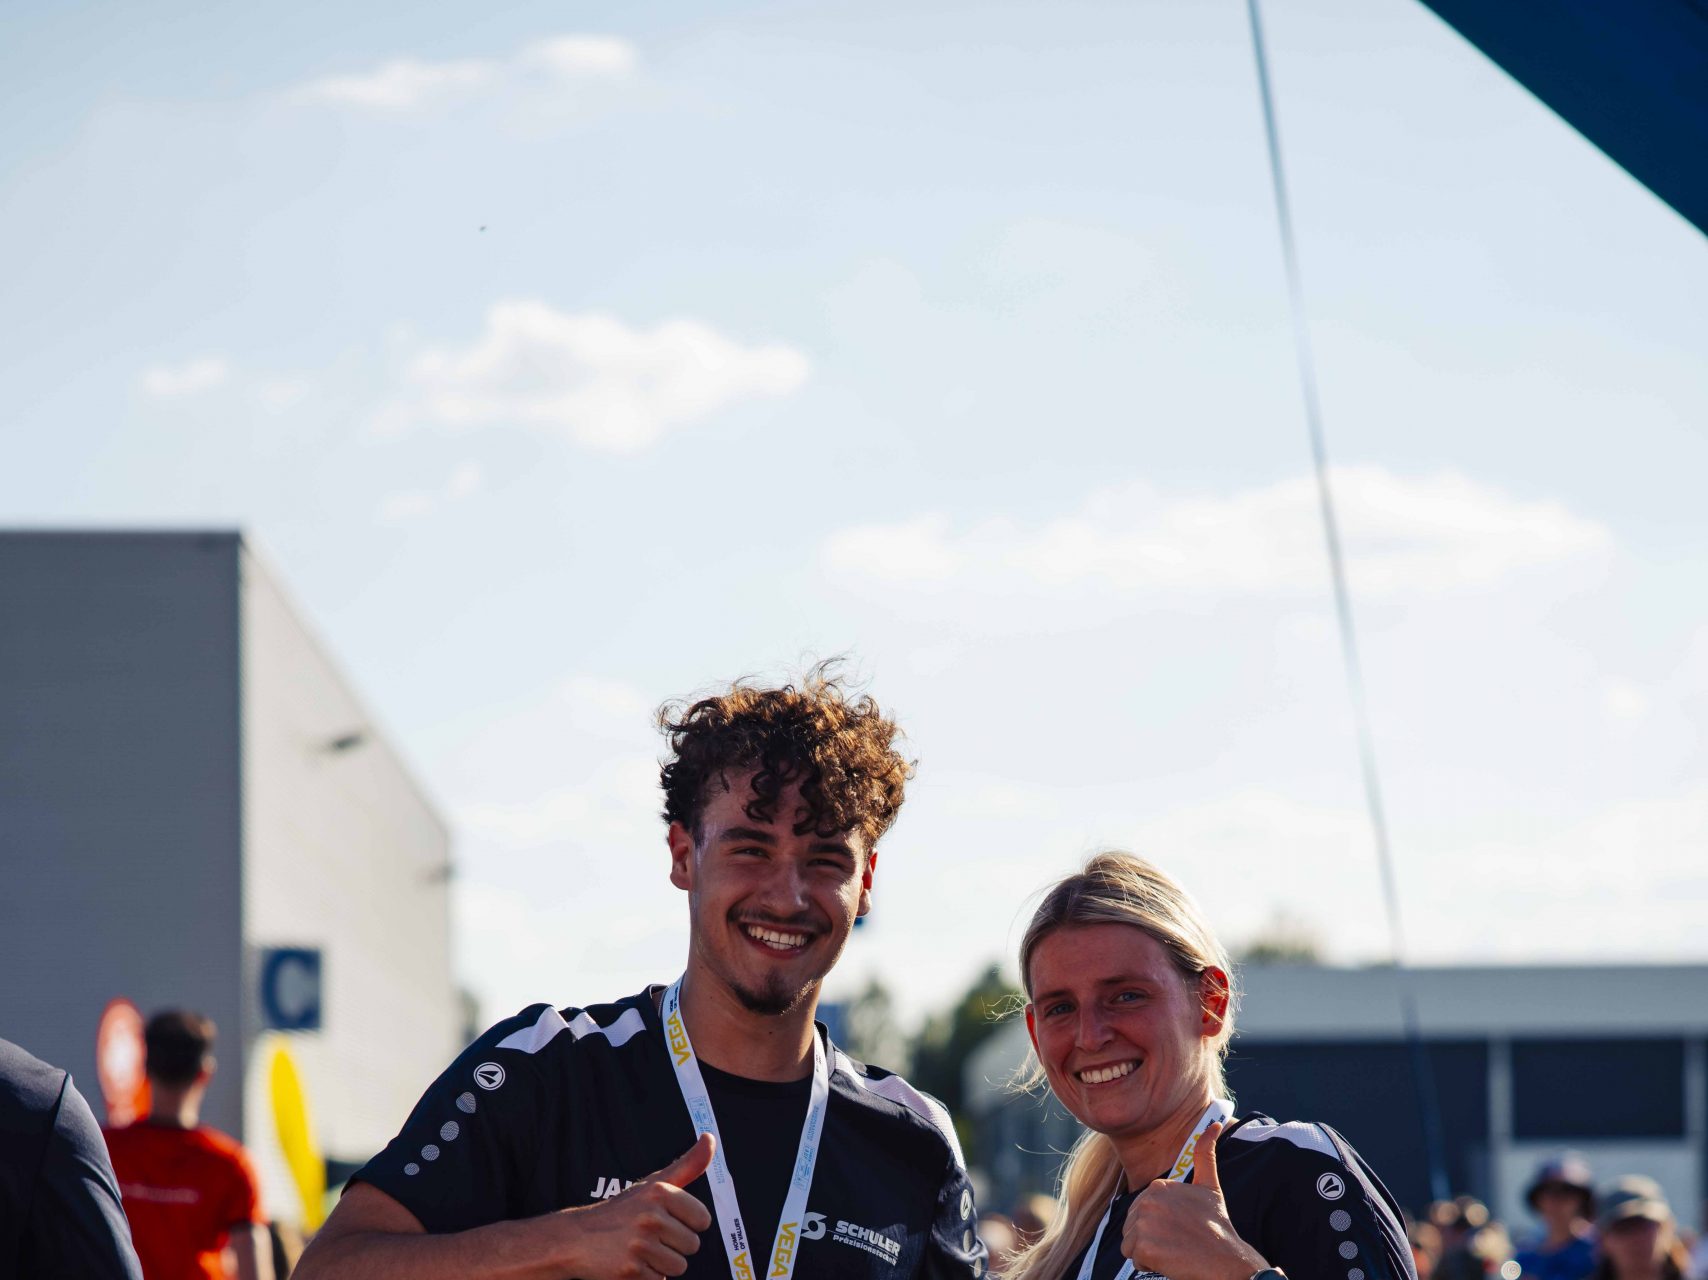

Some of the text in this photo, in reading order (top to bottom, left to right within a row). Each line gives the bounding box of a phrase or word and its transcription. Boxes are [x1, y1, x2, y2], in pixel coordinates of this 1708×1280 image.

[261, 947, 320, 1030] C
[667, 1009, 691, 1067] VEGA
[590, 1176, 633, 1199] JA
[731, 1232, 739, 1251] HOME
[734, 1218, 743, 1241] VALUES
[835, 1220, 901, 1257] SCHULER
[770, 1221, 798, 1278] VEGA
